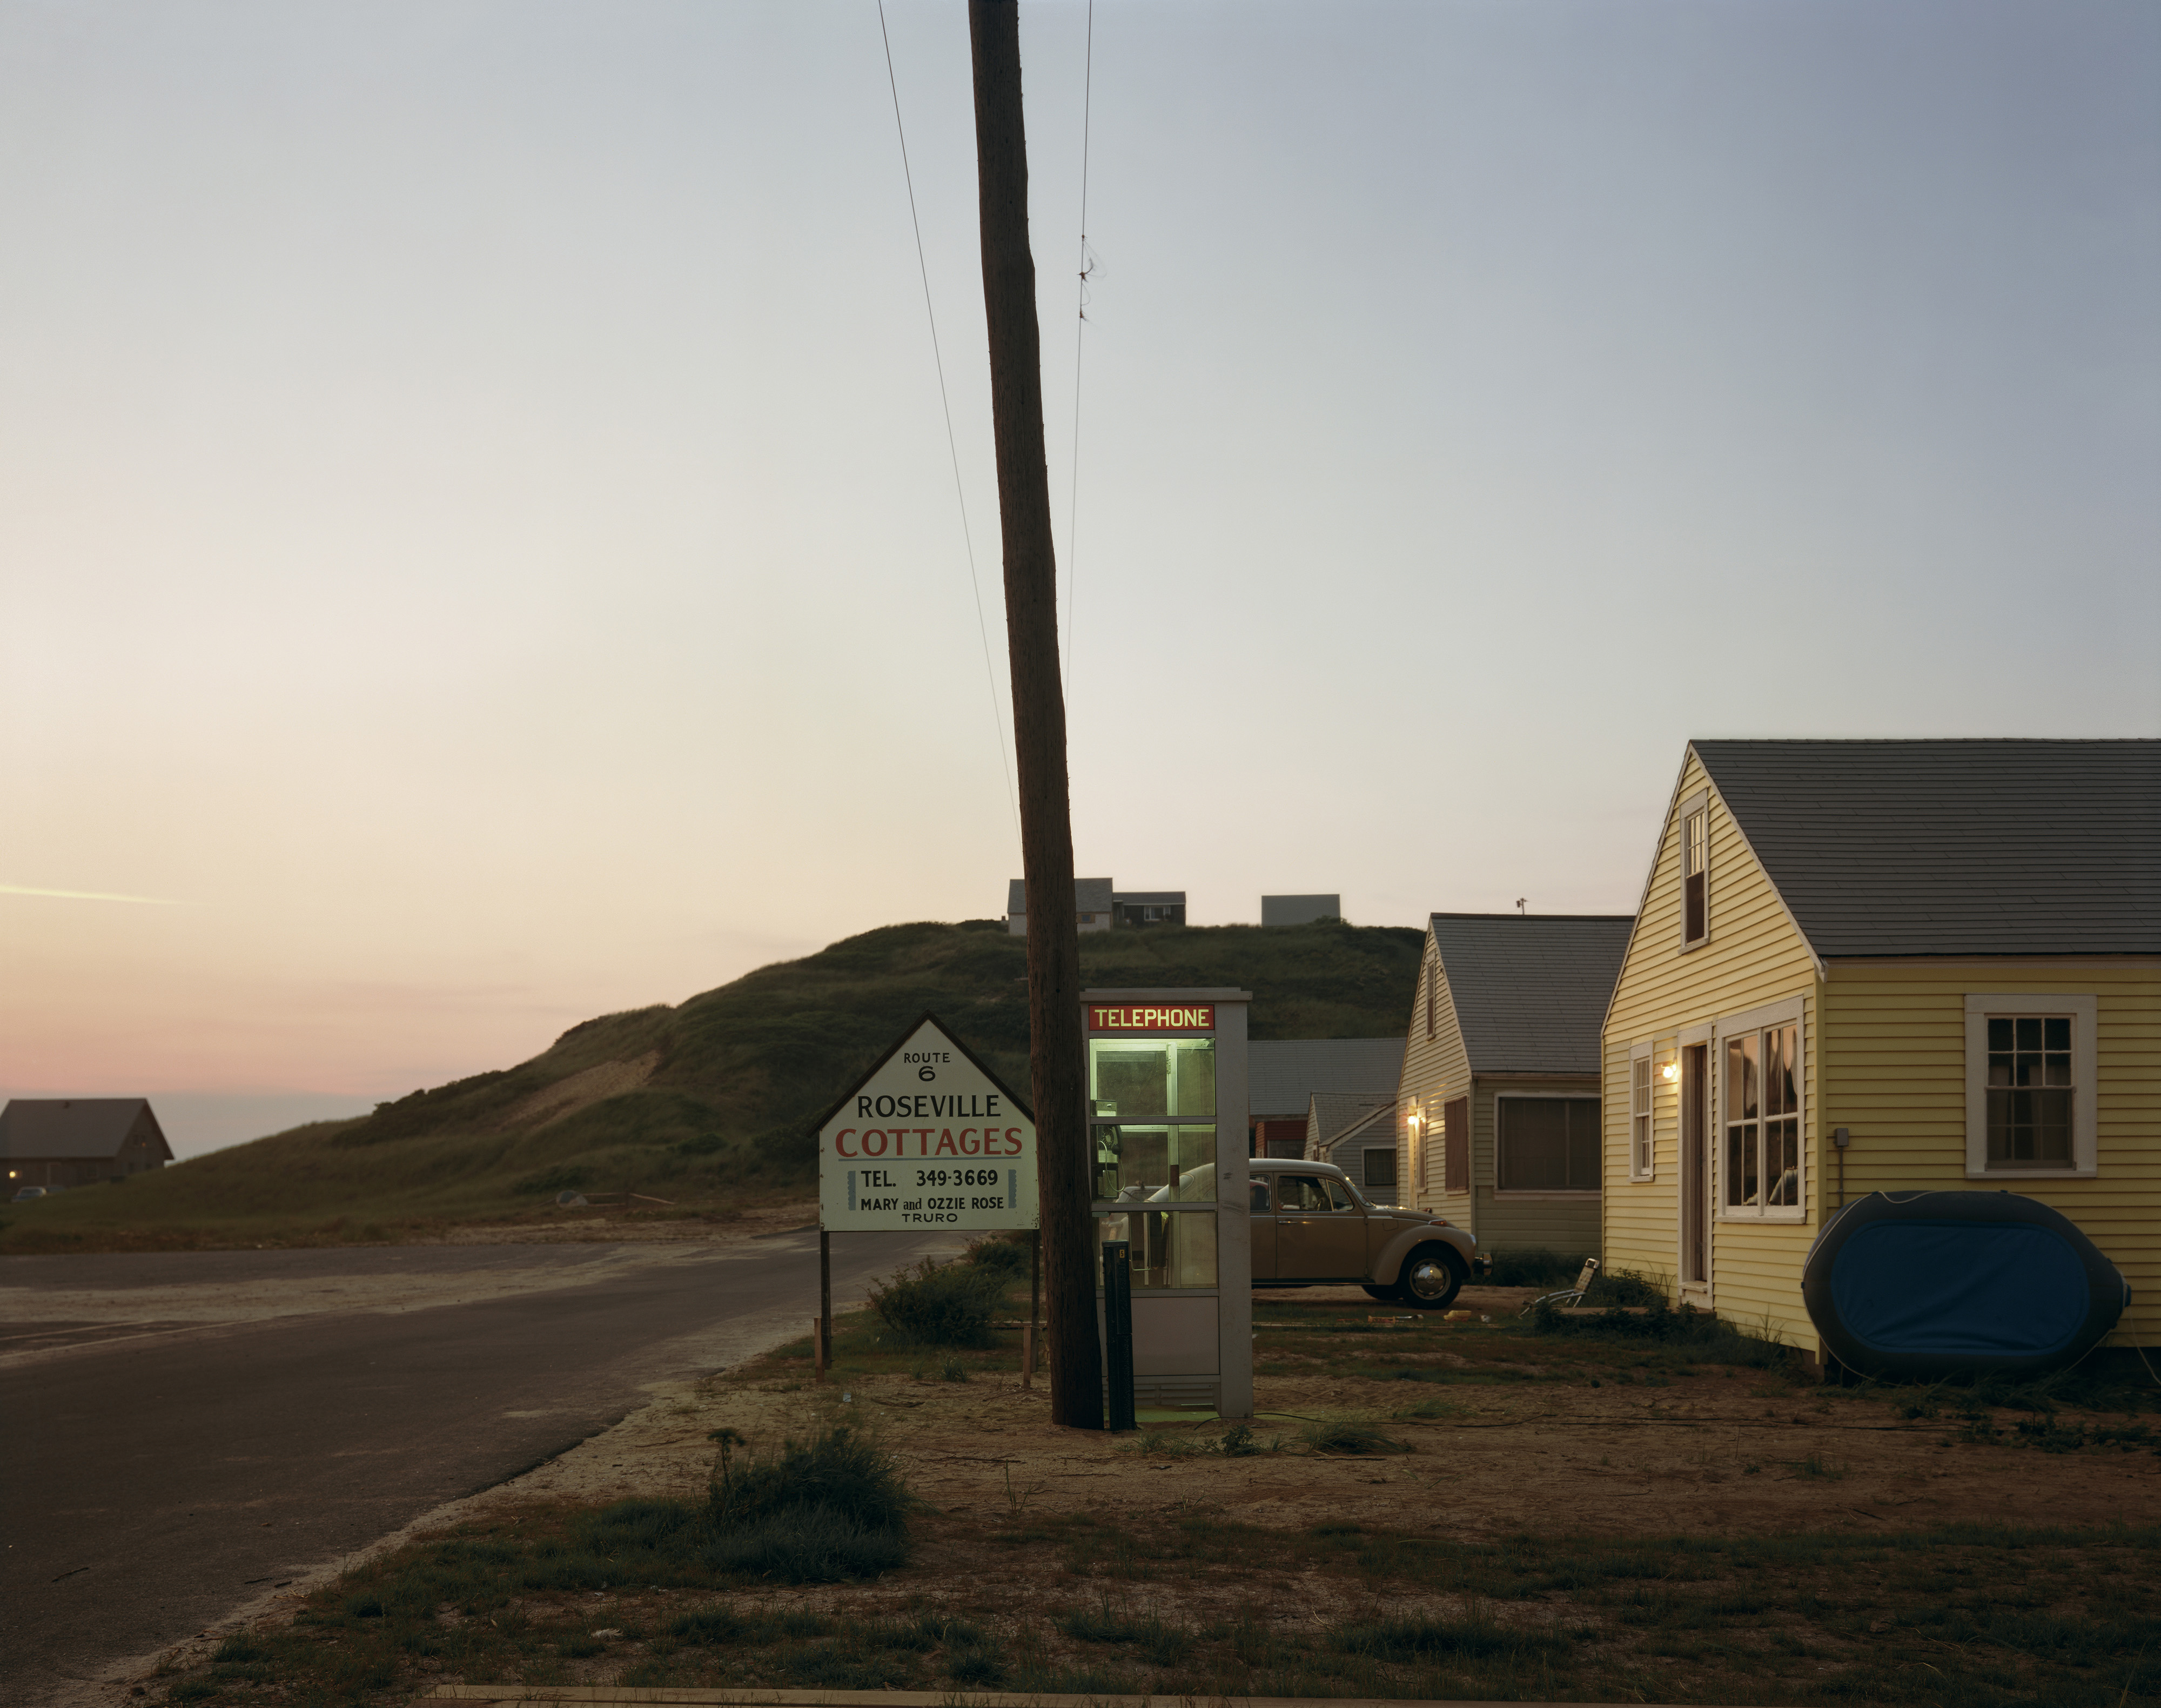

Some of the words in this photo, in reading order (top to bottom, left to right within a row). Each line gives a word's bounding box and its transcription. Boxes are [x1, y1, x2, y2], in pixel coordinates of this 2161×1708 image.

[1095, 1009, 1209, 1026] TELEPHONE
[904, 1053, 950, 1063] ROUTE
[918, 1066, 935, 1081] 6
[858, 1095, 1001, 1117] ROSEVILLE
[836, 1128, 1022, 1157] COTTAGES
[861, 1171, 896, 1187] TEL.
[917, 1170, 998, 1186] 349-3669
[861, 1198, 898, 1210] MARY
[904, 1198, 921, 1210] and
[928, 1198, 965, 1209] OZZIE
[972, 1197, 1004, 1209] ROSE
[902, 1214, 957, 1222] TRURO
